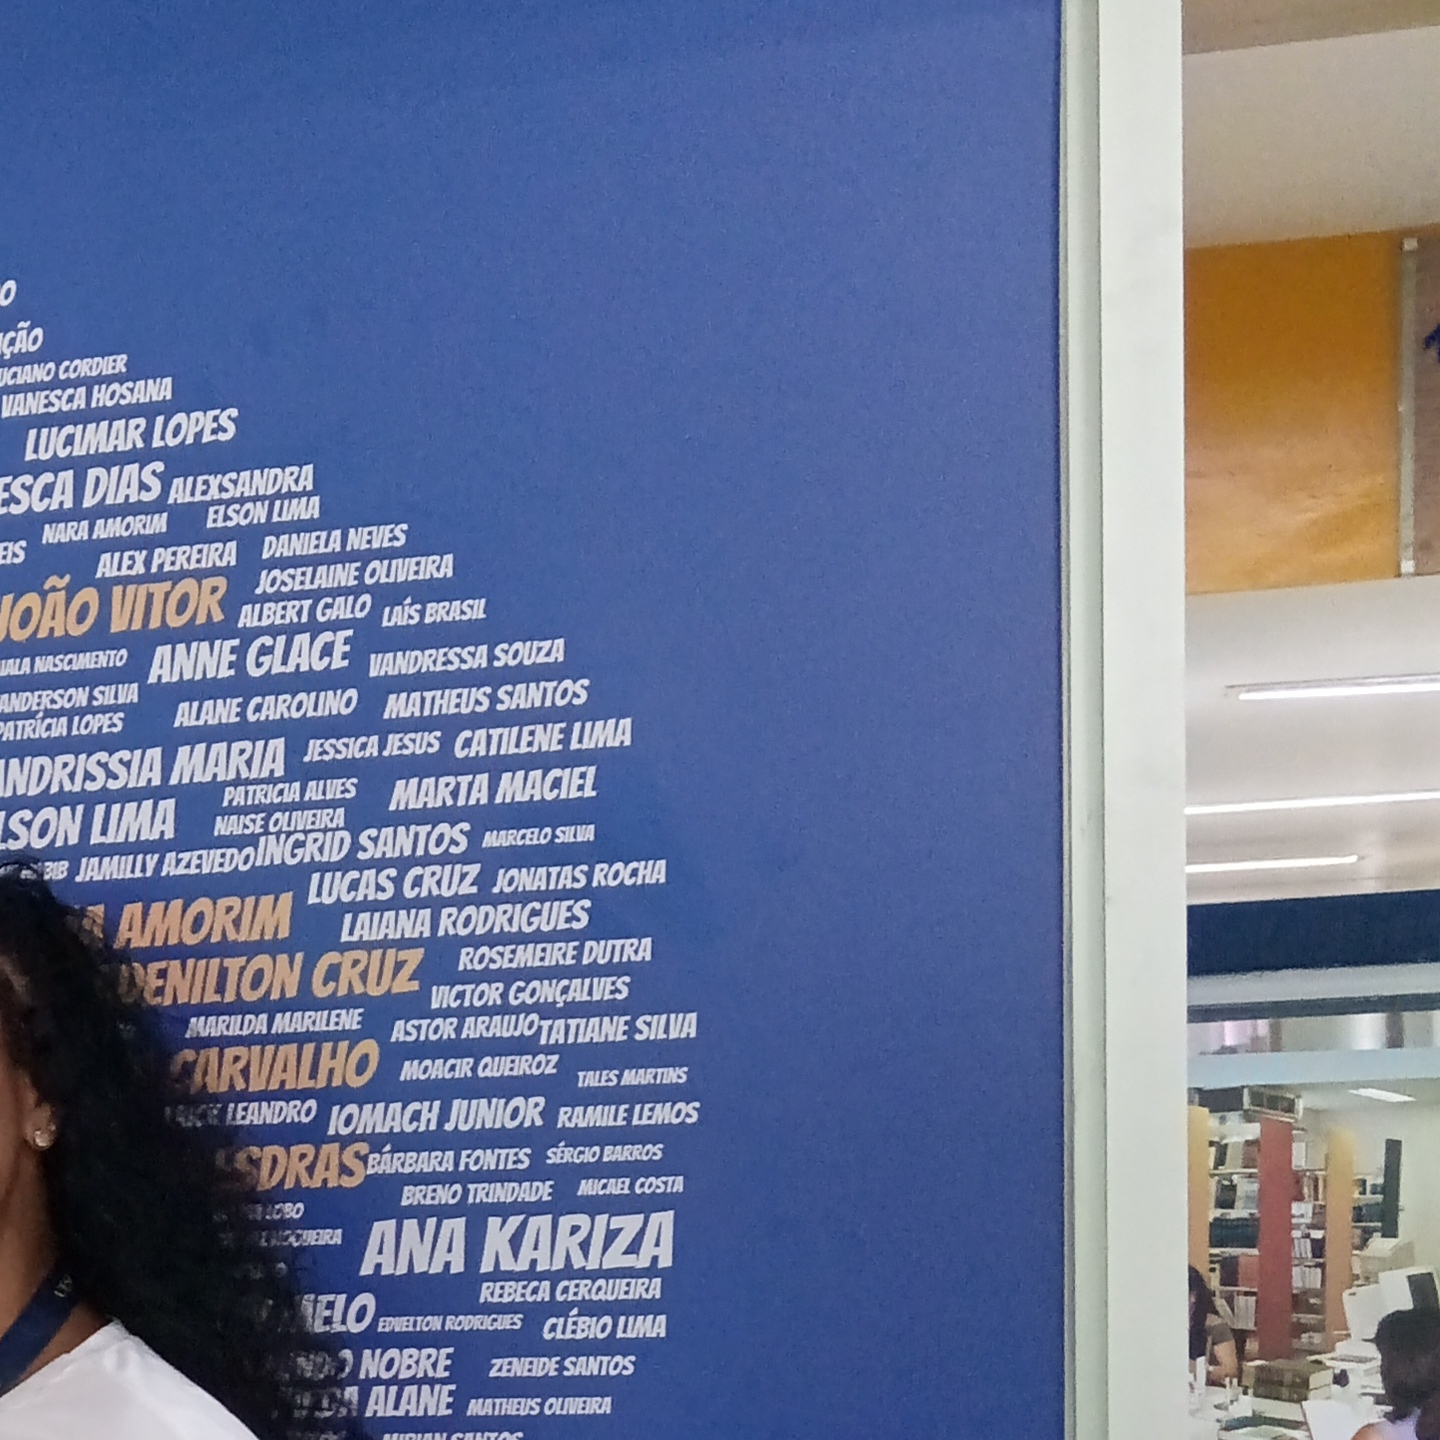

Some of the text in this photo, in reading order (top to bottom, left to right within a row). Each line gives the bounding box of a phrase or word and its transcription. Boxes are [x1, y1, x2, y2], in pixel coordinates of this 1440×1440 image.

[25, 408, 238, 461] LUCIMAR LOPES
[82, 461, 164, 508] DIAS
[110, 576, 227, 633] VITOR
[147, 629, 353, 684] ANNE GLACE
[389, 766, 596, 810] MARTA MACIEL
[308, 864, 481, 904] LUCAS CRUZ
[359, 1210, 674, 1275] ANA KARIZA
[543, 1307, 666, 1340] CLÉBIO LIMA
